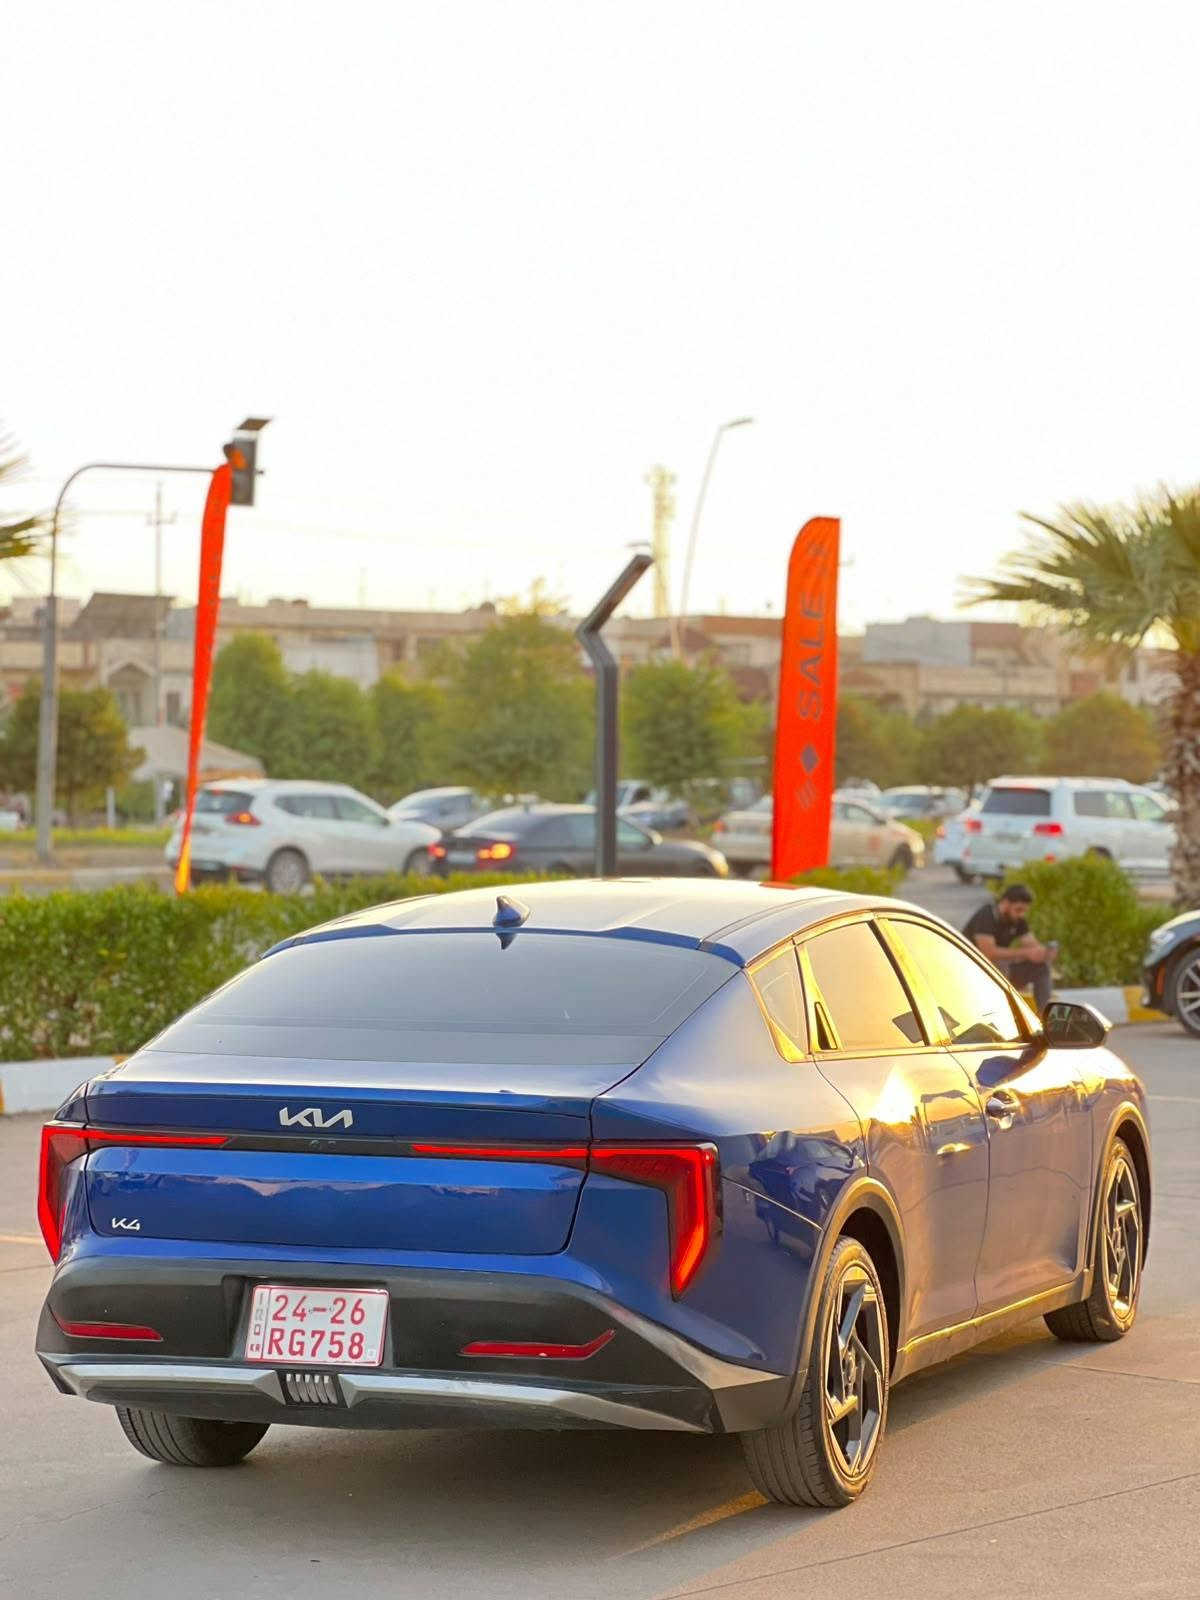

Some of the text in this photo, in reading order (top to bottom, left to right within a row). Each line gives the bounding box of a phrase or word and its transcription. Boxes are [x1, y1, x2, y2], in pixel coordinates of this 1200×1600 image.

[279, 1107, 353, 1128] KIA
[111, 1217, 141, 1231] K4
[272, 1294, 366, 1325] 24-26
[267, 1328, 365, 1359] RG758
